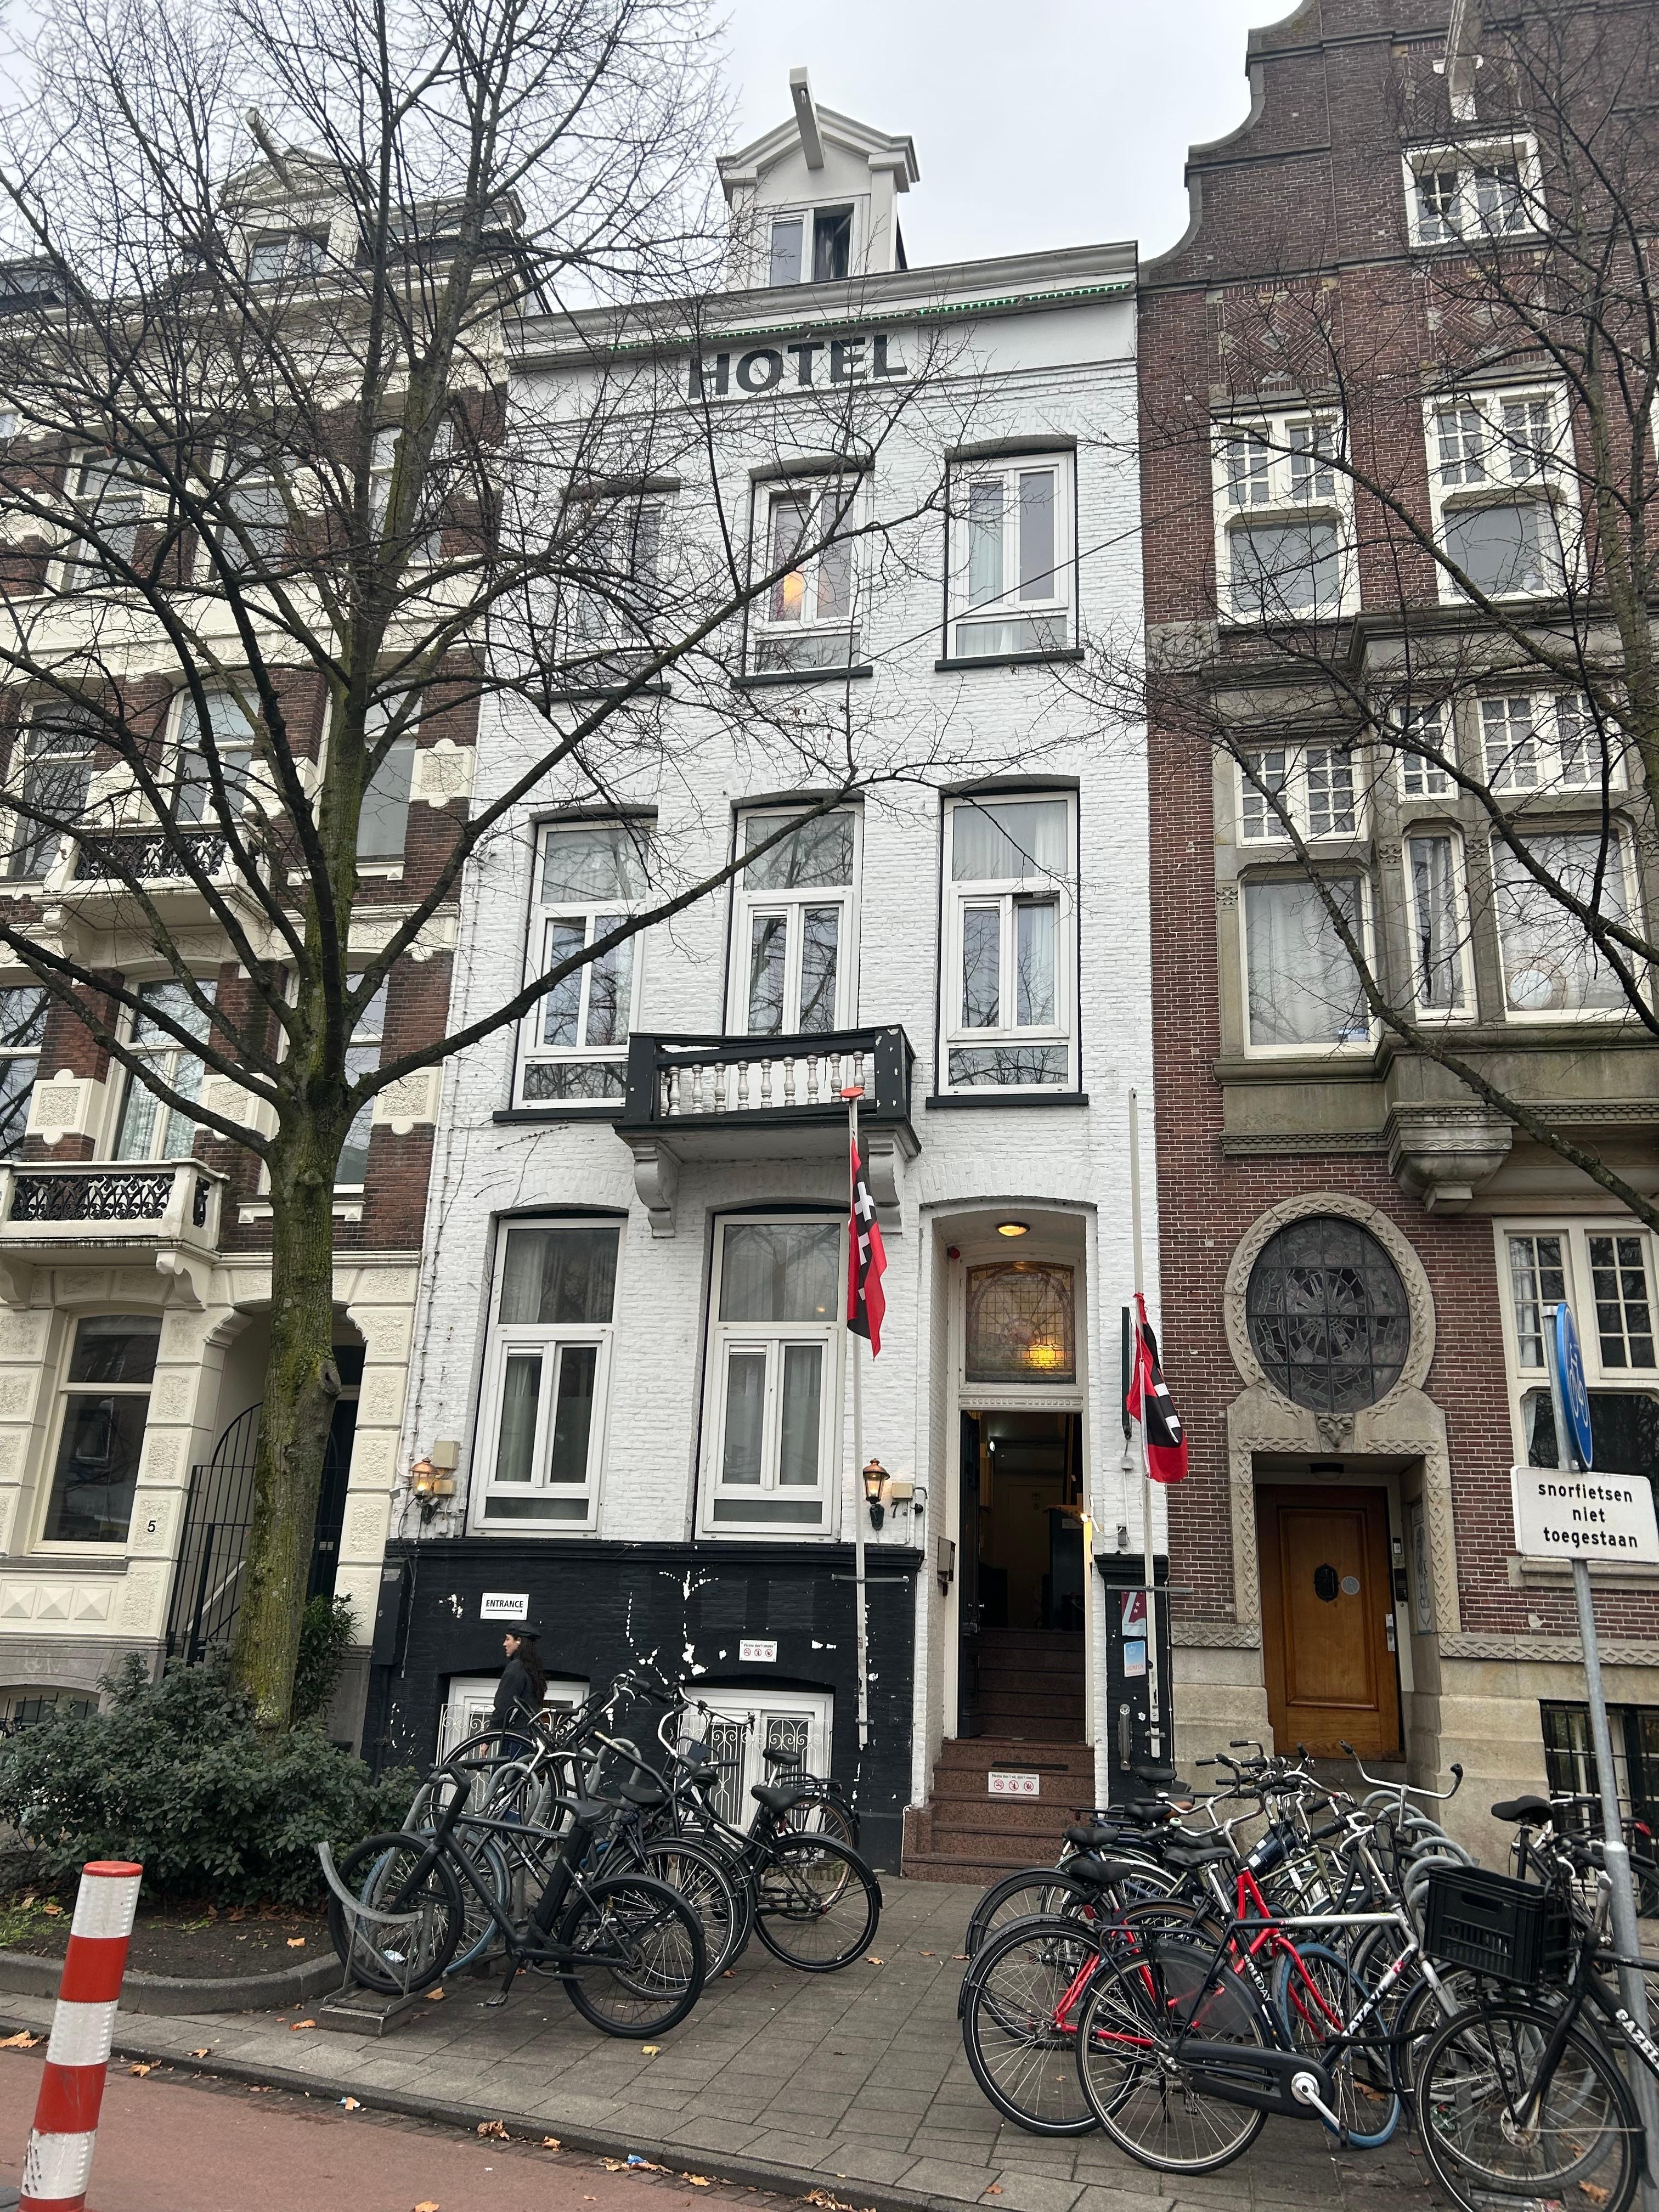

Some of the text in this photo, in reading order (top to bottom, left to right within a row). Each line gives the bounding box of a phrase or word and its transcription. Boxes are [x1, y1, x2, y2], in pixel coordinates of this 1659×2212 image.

[688, 334, 907, 399] HOTEL
[1538, 1483, 1633, 1503] snorfietsen
[890, 1502, 900, 1519] 7
[1572, 1506, 1606, 1522] niet
[147, 1520, 156, 1532] 5
[1543, 1527, 1638, 1548] toegestaan
[486, 1599, 524, 1608] ENTRANCE
[1243, 1954, 1273, 2001] HOLIDAY
